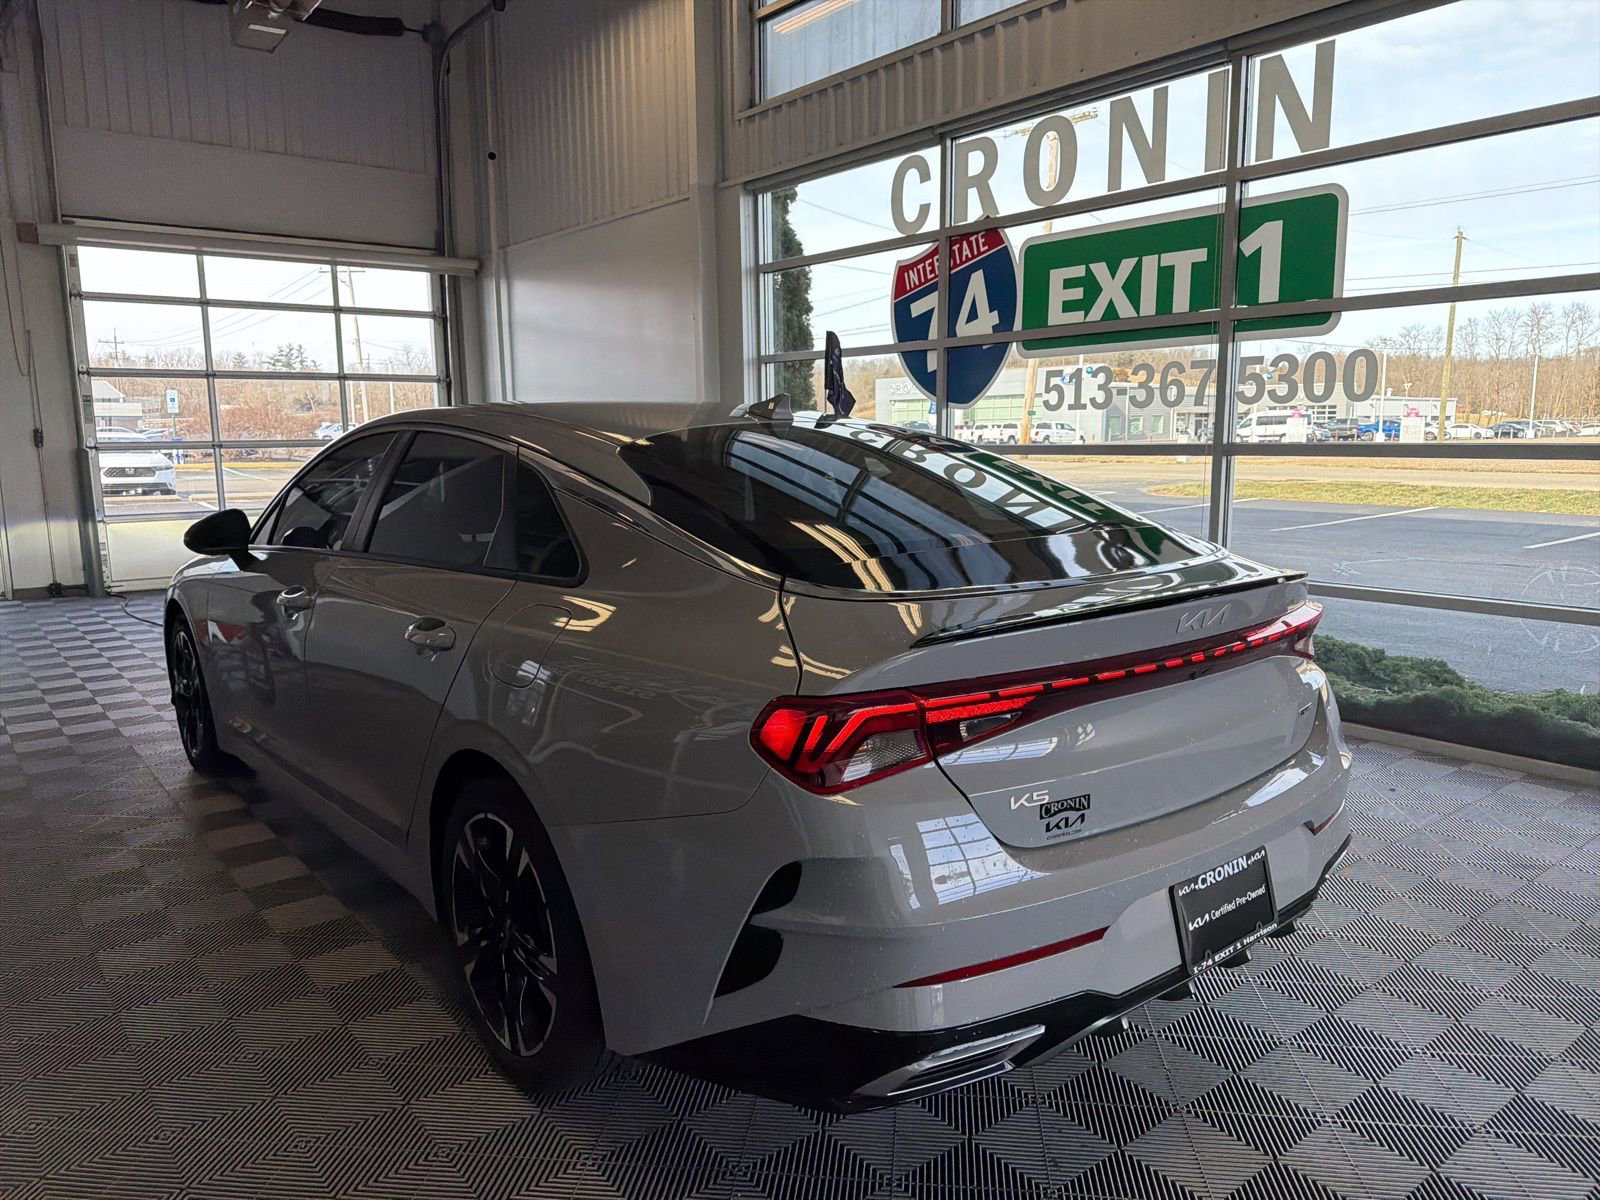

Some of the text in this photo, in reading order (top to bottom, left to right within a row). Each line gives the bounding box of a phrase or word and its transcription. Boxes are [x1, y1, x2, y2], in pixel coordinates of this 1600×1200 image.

[891, 39, 1336, 236] CRONIN
[904, 232, 988, 291] INTERTATE
[1048, 220, 1283, 326] EXIT 1
[910, 269, 1000, 373] 74
[1042, 348, 1379, 412] 513-3675300
[1175, 603, 1232, 634] KIA
[1010, 789, 1050, 811] K5
[1041, 795, 1089, 818] CRONIN
[1045, 812, 1086, 833] KIA
[1197, 855, 1248, 890] CRONIN
[1188, 883, 1267, 931] KIA Certified Pre-Owned
[1214, 944, 1235, 962] EXIT
[1243, 922, 1279, 946] Harrison
